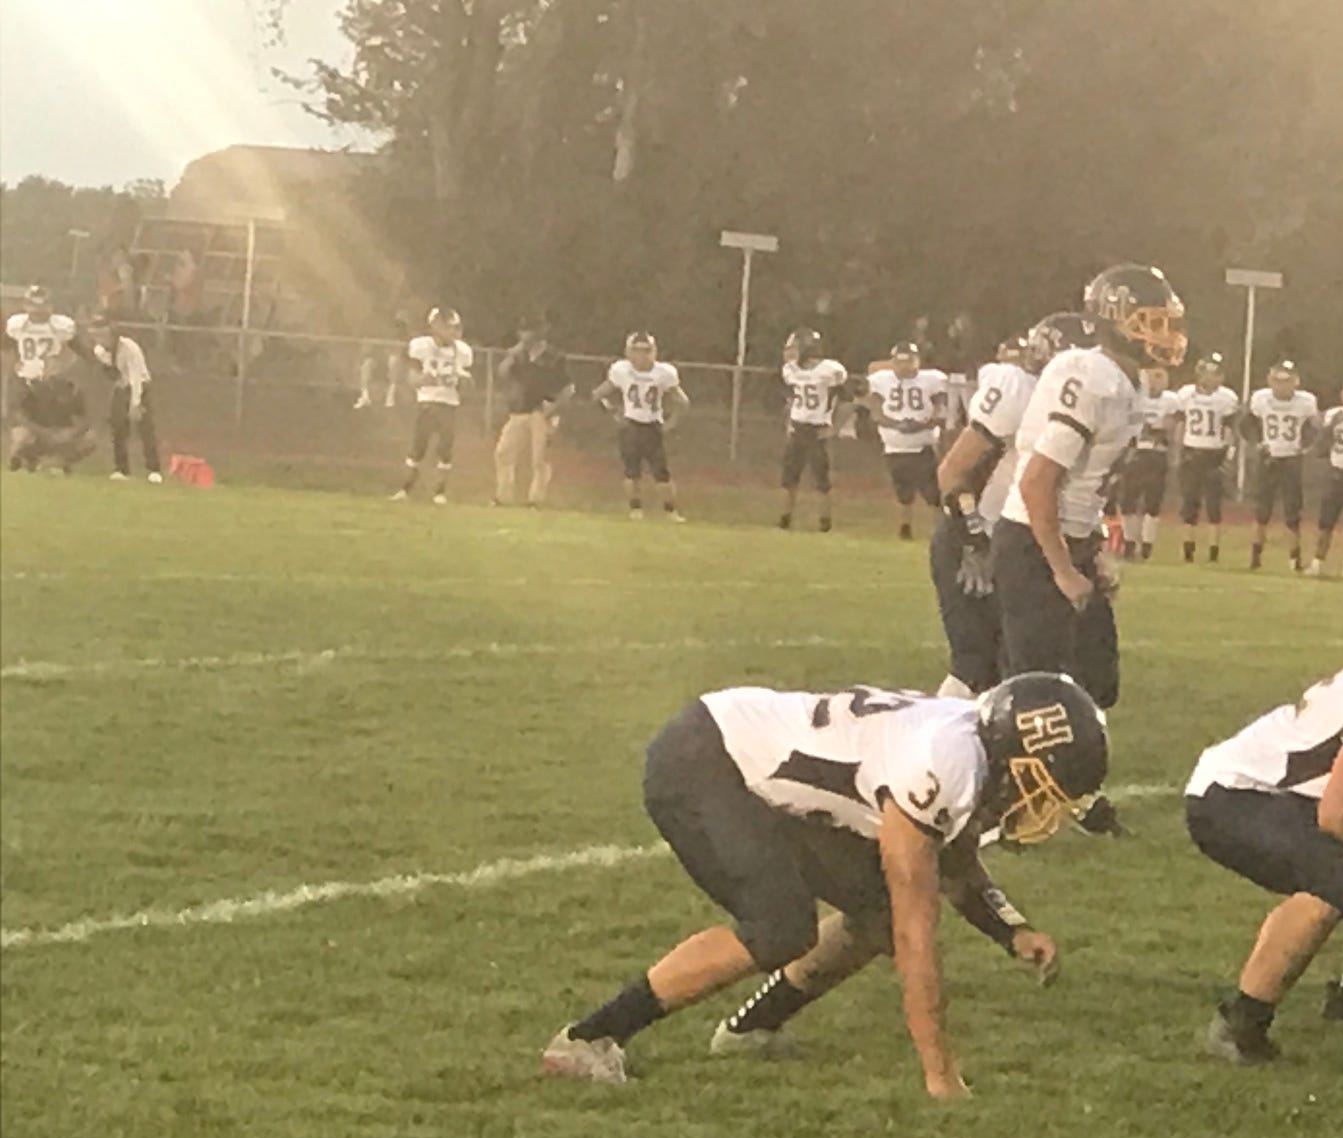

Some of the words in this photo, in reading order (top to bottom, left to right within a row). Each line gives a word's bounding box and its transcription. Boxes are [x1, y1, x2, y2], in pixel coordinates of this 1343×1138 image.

[628, 384, 660, 413] 44
[889, 386, 924, 411] 98
[980, 387, 1002, 414] 9
[1060, 377, 1083, 409] 6
[1189, 409, 1215, 436] 21
[1267, 414, 1297, 441] 63
[1016, 704, 1073, 753] H
